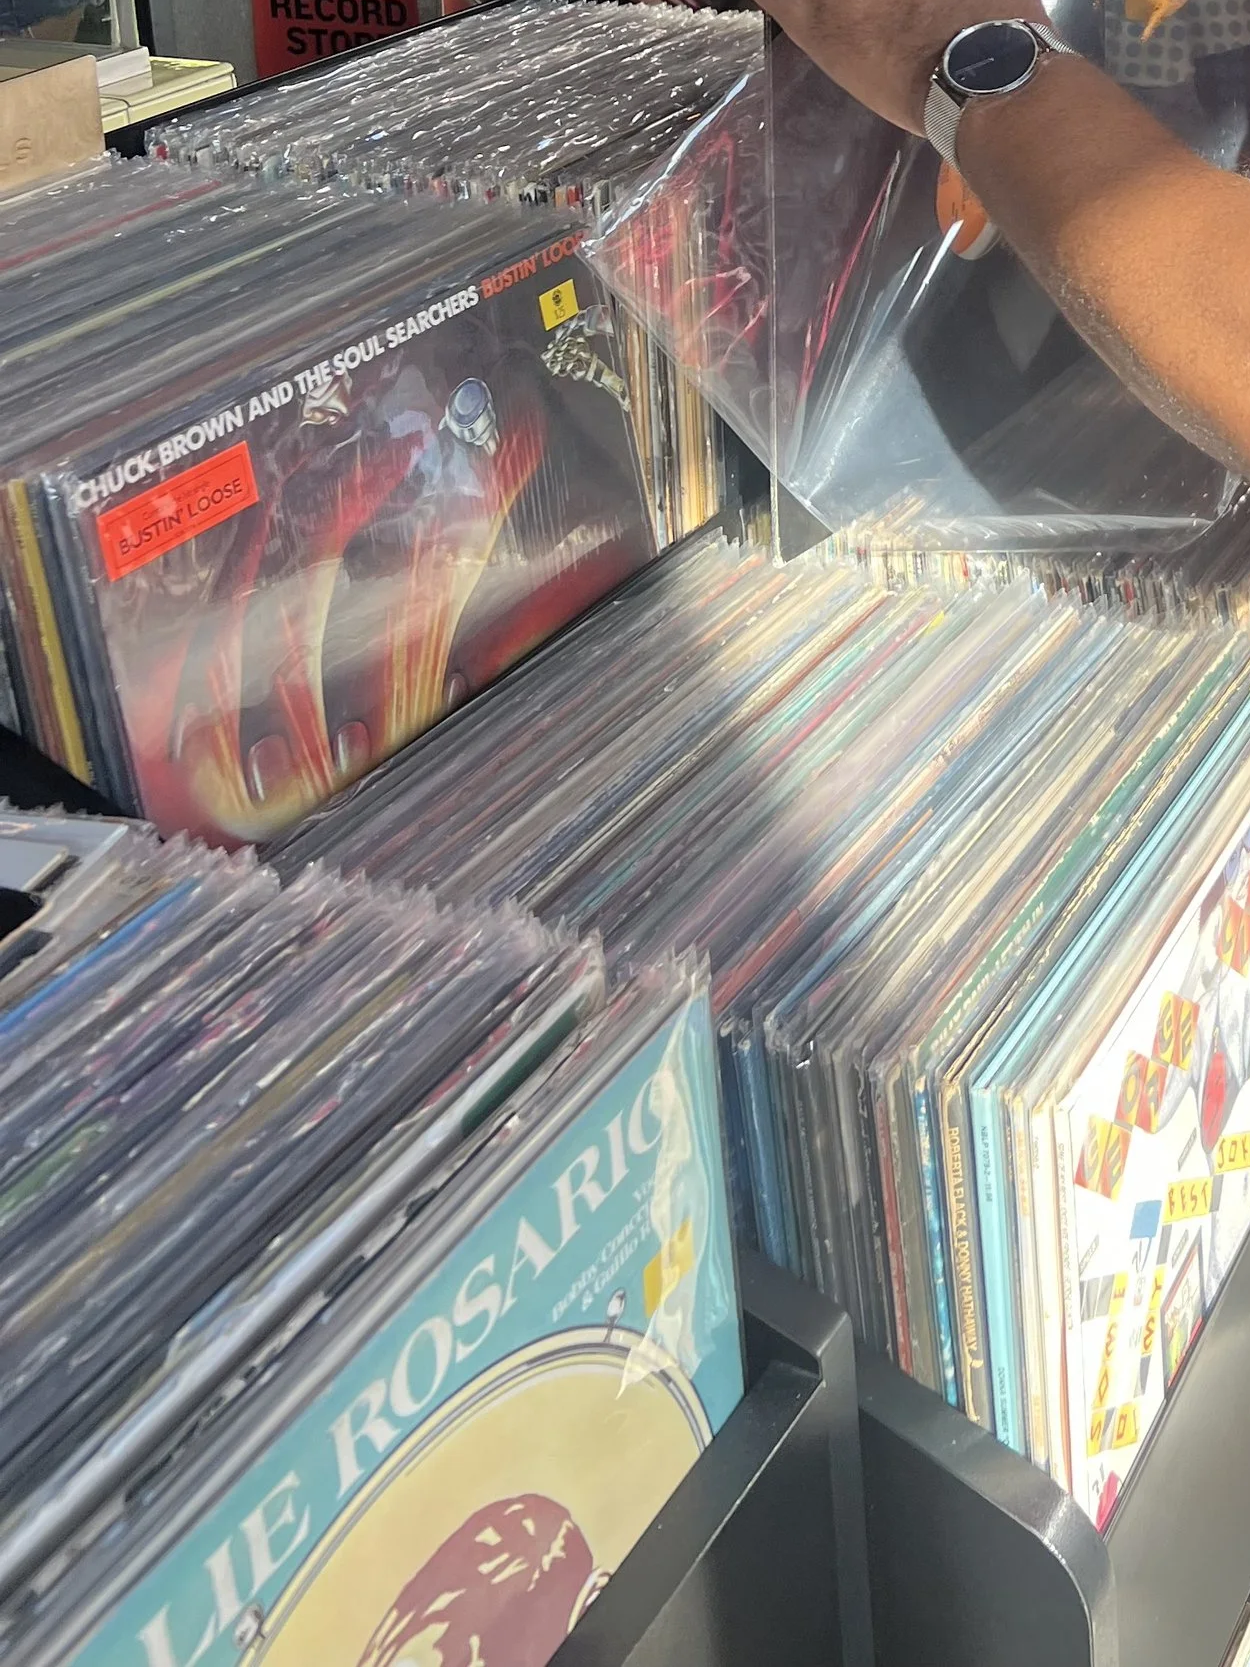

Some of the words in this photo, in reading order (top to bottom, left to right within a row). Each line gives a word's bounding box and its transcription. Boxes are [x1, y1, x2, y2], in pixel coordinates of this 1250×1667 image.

[75, 449, 156, 509] CHUCK
[157, 406, 243, 468] BROWN
[247, 381, 294, 424] AND
[293, 360, 334, 398] THE
[332, 334, 386, 377] SOUL
[385, 285, 480, 351] SEARCHERS
[480, 251, 538, 300] BUSTIN'
[119, 508, 184, 556] BUSTIN'
[187, 477, 243, 518] LOOSE
[948, 1126, 963, 1184] ROBERTA
[953, 1186, 967, 1227] FLACK
[1168, 1183, 1209, 1215] BEST
[957, 1240, 972, 1284] DONNY
[322, 1071, 678, 1500] ROSARIO
[582, 1290, 594, 1313] &
[960, 1284, 978, 1351] HATHAWAY
[998, 1366, 1007, 1396] DONNA
[1000, 1397, 1010, 1433] SUMMER
